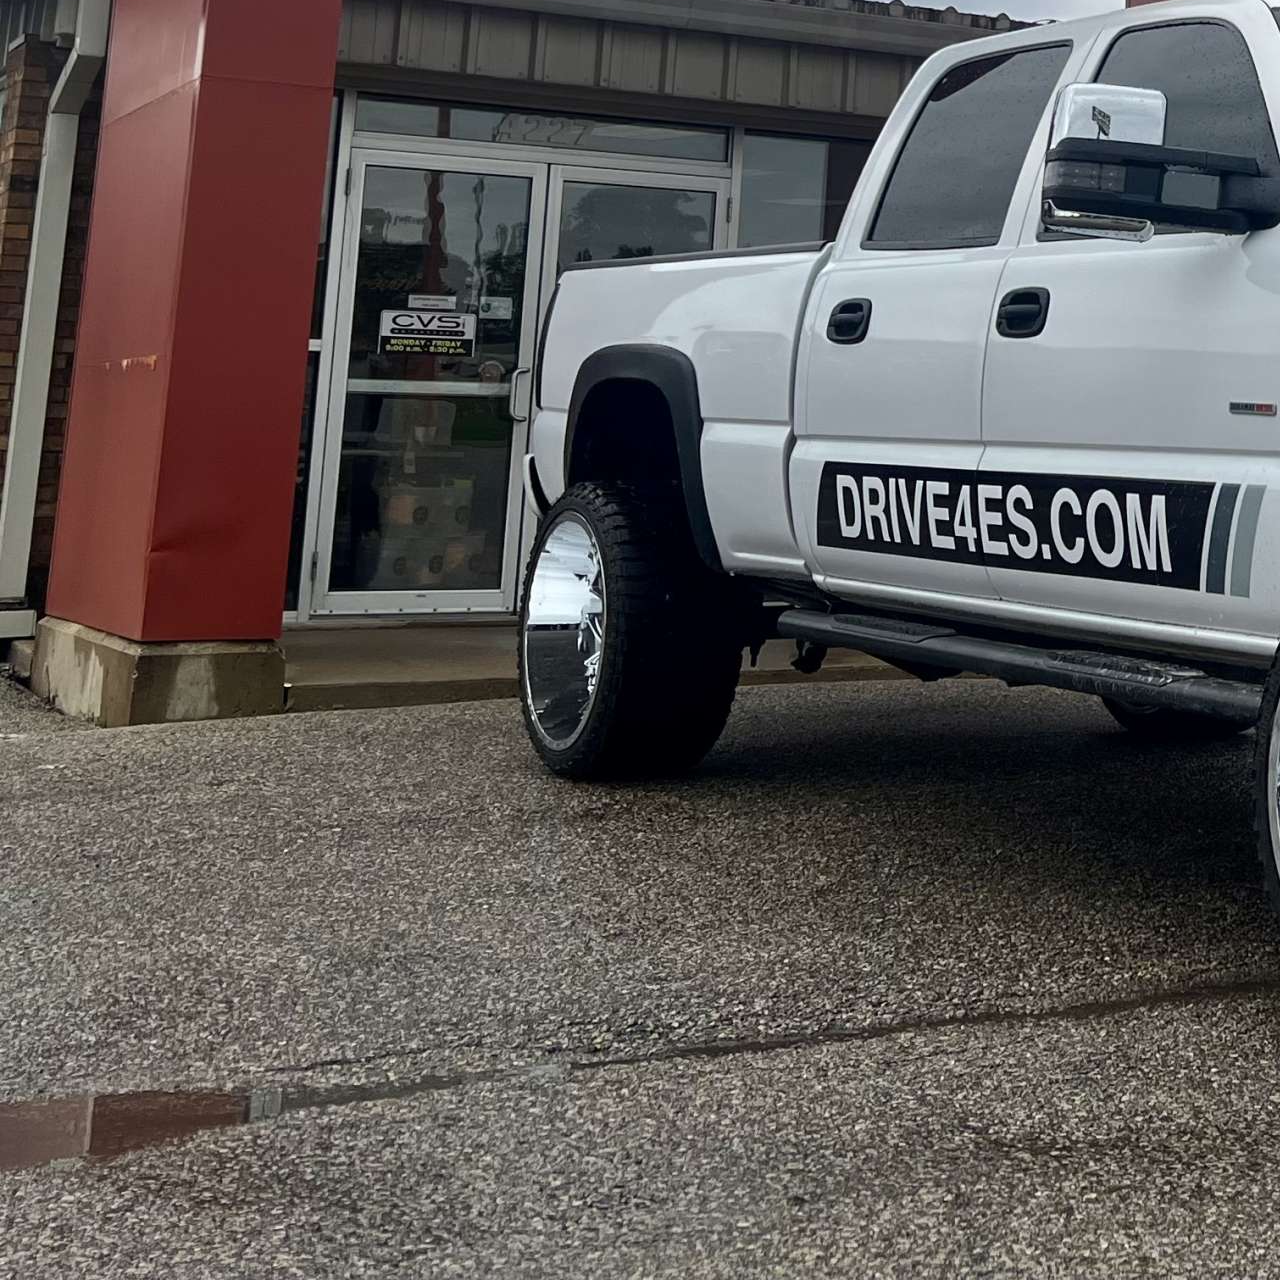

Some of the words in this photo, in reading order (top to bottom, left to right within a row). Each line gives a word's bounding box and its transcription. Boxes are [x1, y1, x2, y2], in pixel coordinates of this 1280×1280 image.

[390, 338, 425, 347] MONDAY
[432, 340, 462, 348] FRIDAY
[836, 474, 1173, 573] DRIVE4ES.COM
